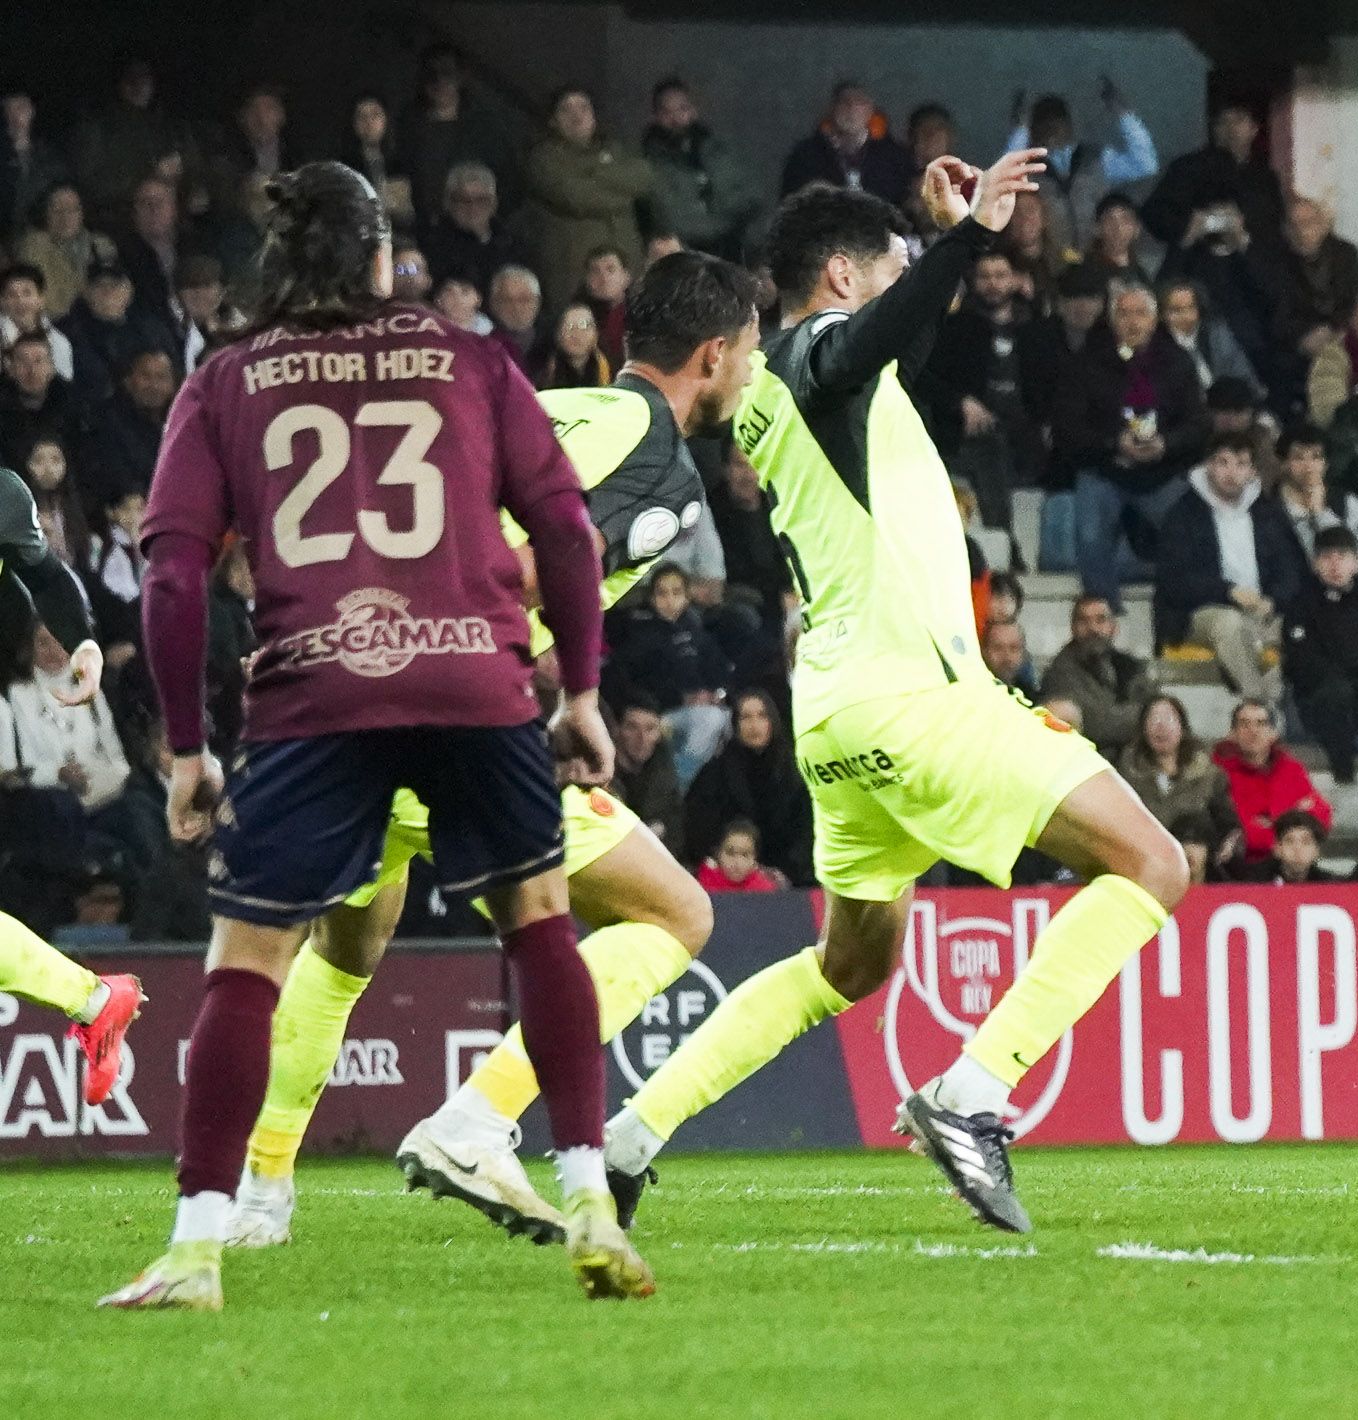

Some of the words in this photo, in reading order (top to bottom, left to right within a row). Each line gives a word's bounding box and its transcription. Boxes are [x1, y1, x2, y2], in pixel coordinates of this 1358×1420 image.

[243, 352, 366, 395] HECTOR
[376, 348, 455, 382] HDEZ
[263, 401, 446, 568] 23
[952, 939, 1000, 978] COPA
